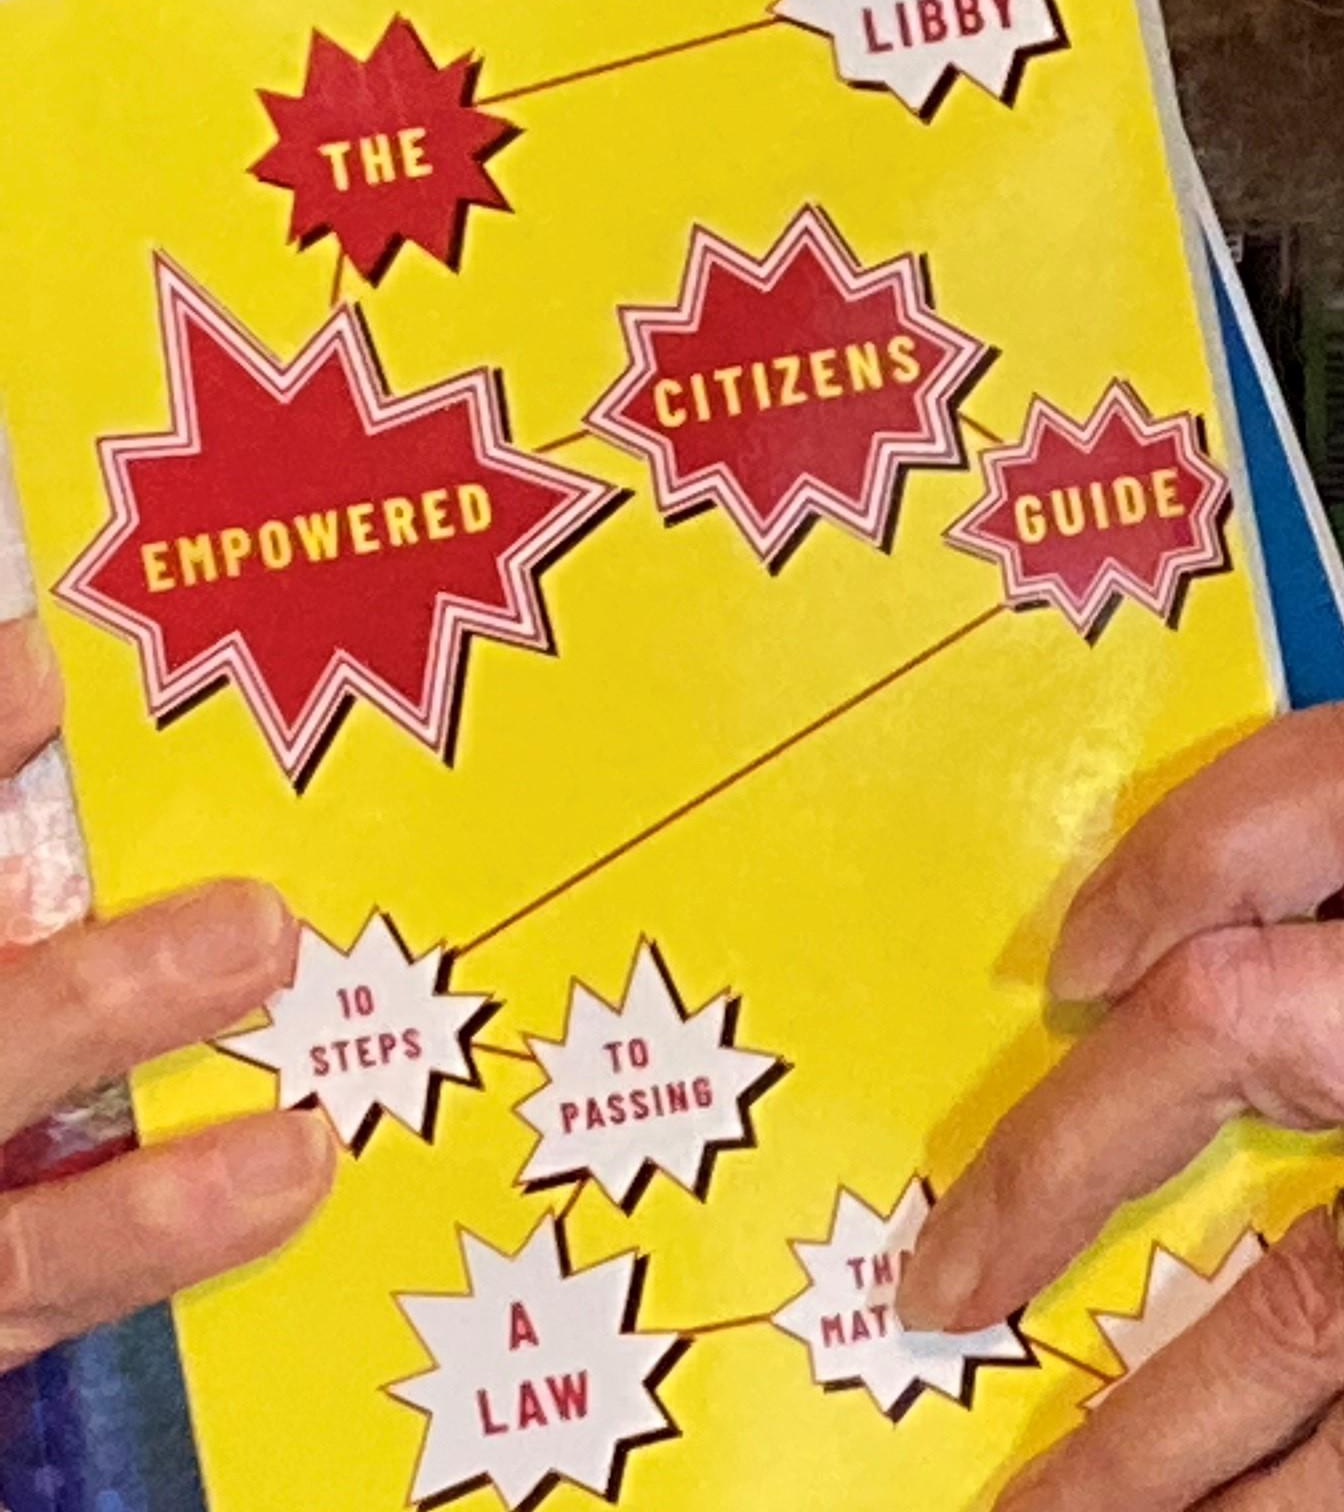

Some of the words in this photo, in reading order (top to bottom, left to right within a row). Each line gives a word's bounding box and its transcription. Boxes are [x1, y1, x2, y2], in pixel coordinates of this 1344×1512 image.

[318, 127, 433, 191] THE
[654, 336, 921, 428] CITIZENS
[1014, 468, 1185, 543] GUIDE
[140, 483, 493, 592] EMPOWERED
[337, 986, 374, 1019] 10
[309, 1029, 423, 1076] STEPS
[603, 1038, 649, 1074] TO
[559, 1077, 714, 1134] PASSING
[846, 1251, 908, 1290] TH
[508, 1302, 540, 1350] A
[821, 1308, 889, 1347] MAT
[477, 1371, 589, 1436] LAW
